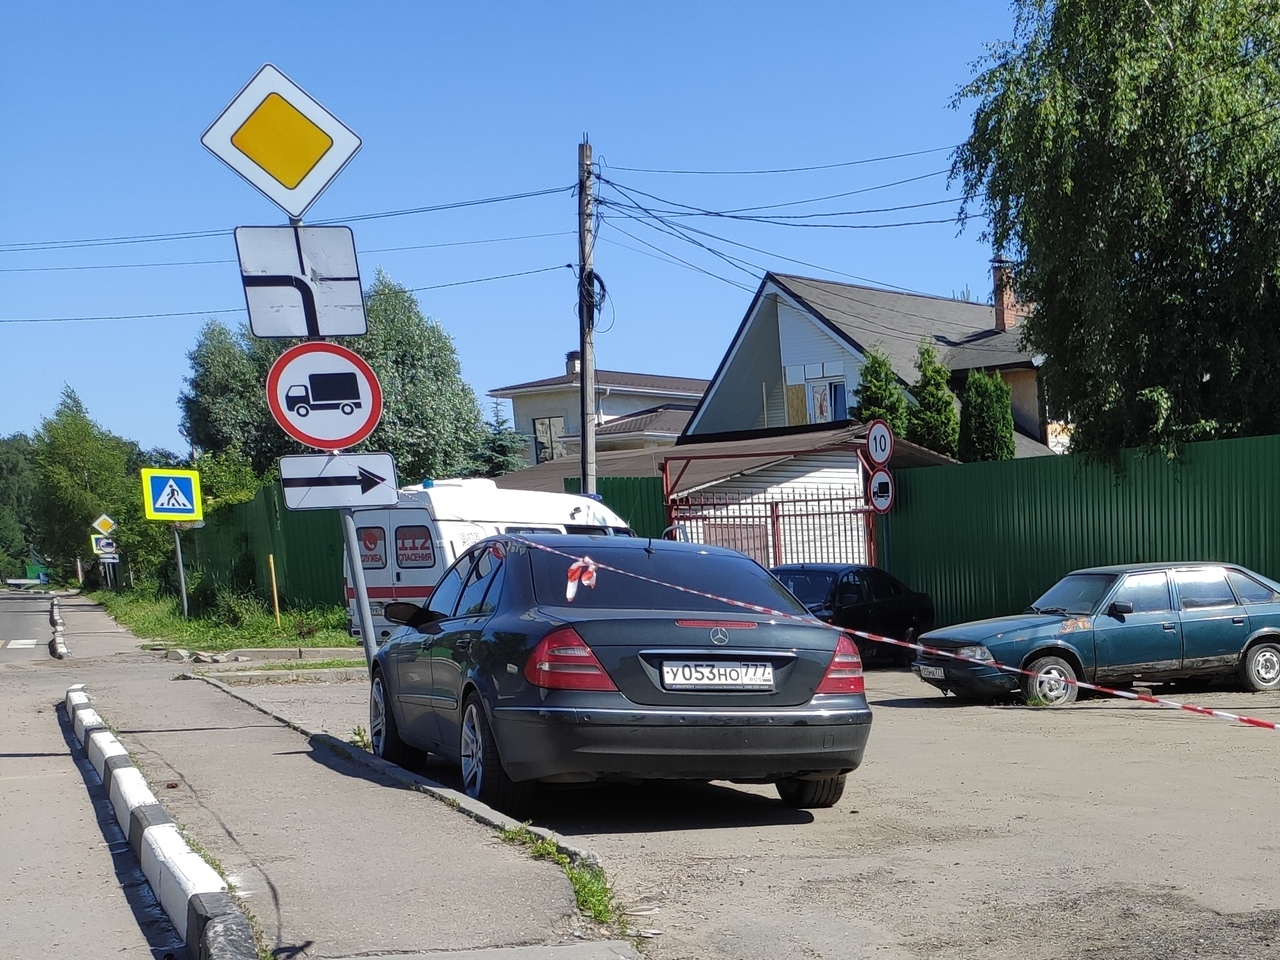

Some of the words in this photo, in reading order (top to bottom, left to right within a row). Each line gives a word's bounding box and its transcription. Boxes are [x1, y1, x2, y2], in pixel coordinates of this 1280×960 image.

[873, 434, 887, 453] 10
[398, 530, 430, 551] 112
[399, 552, 432, 562] СПАСЕНИЯ
[670, 664, 740, 681] У053НО
[742, 663, 767, 677] 777
